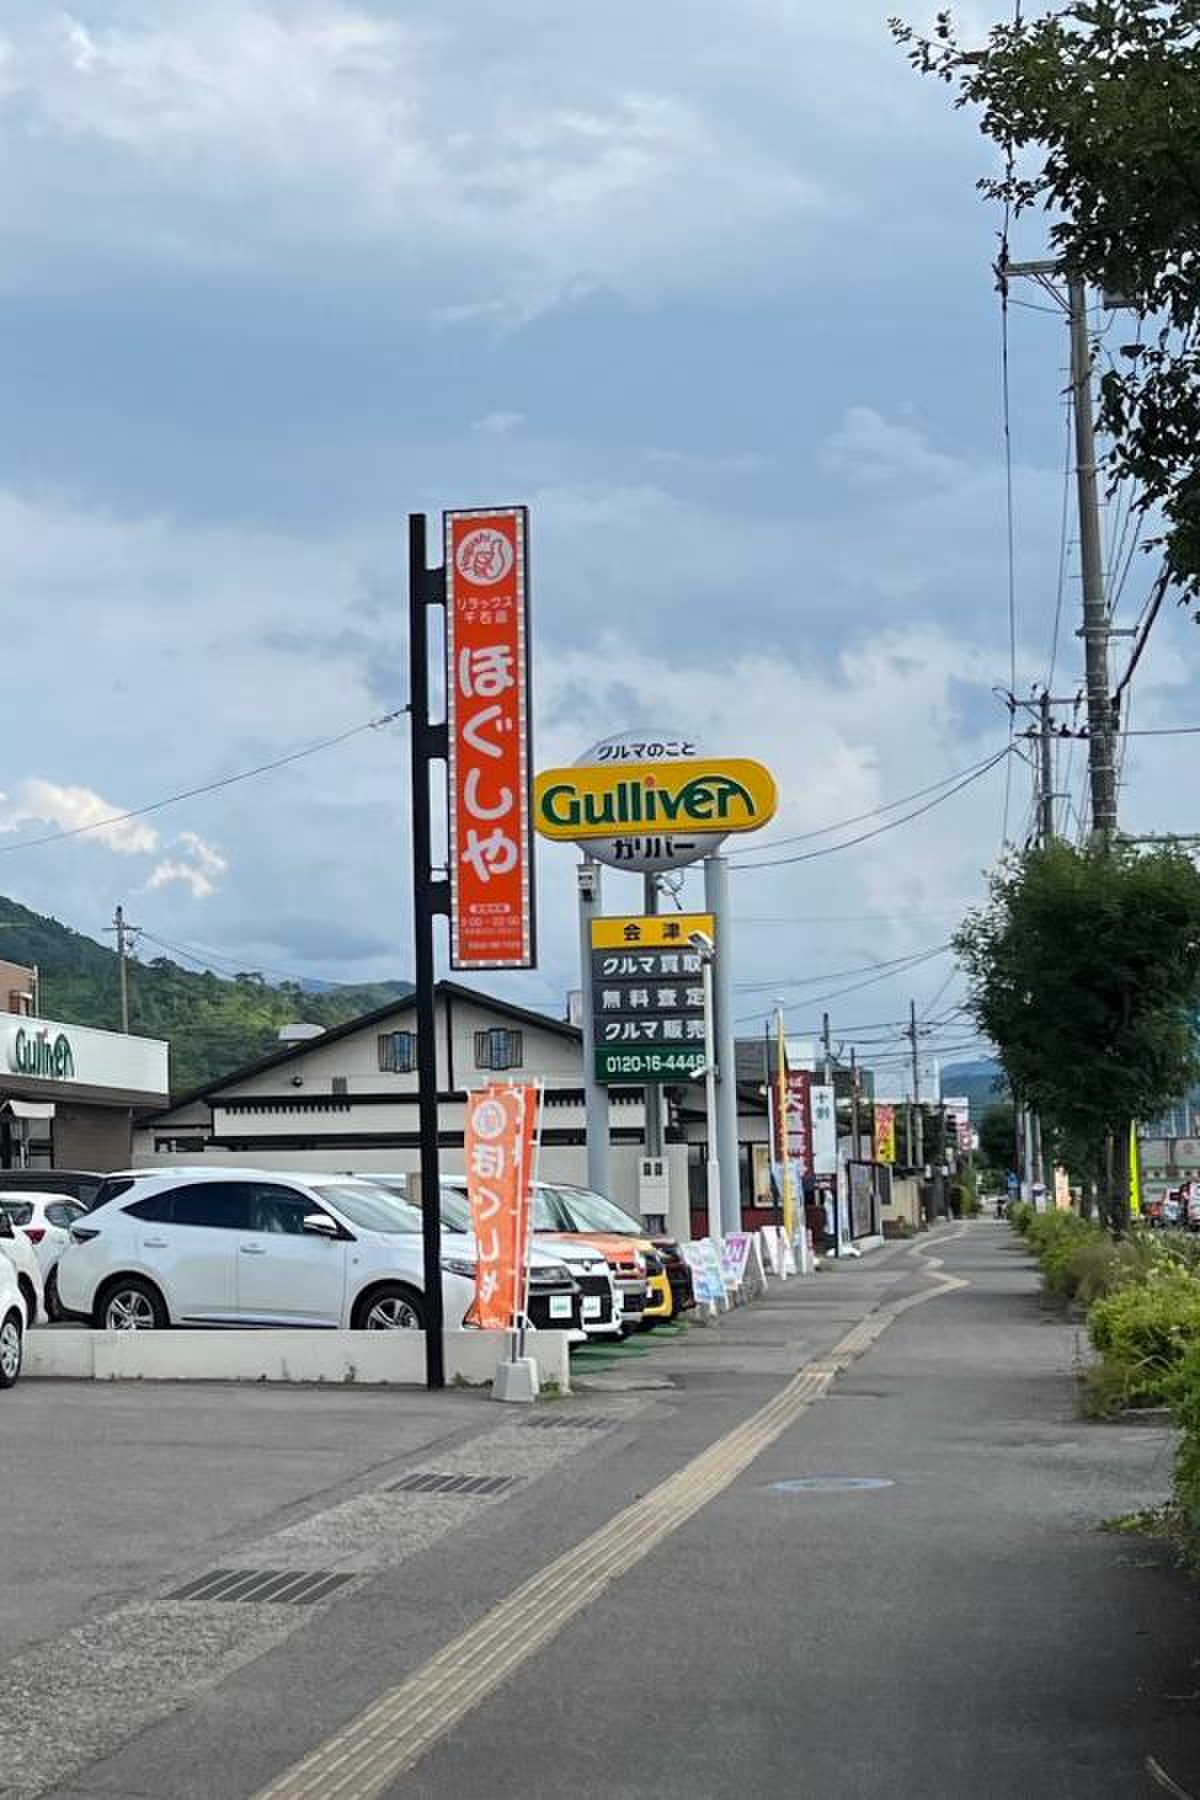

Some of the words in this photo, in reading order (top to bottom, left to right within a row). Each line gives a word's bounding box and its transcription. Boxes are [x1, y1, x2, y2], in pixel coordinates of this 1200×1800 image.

[597, 741, 697, 761] クルマのこと
[459, 644, 519, 883] ほぐしや
[541, 773, 755, 826] Gulliver
[612, 836, 696, 860] ガリバー
[623, 922, 681, 941] 会津
[602, 987, 705, 1009] 無料査定
[605, 1020, 706, 1041] クルマ販売
[15, 1026, 75, 1078] Gulliver
